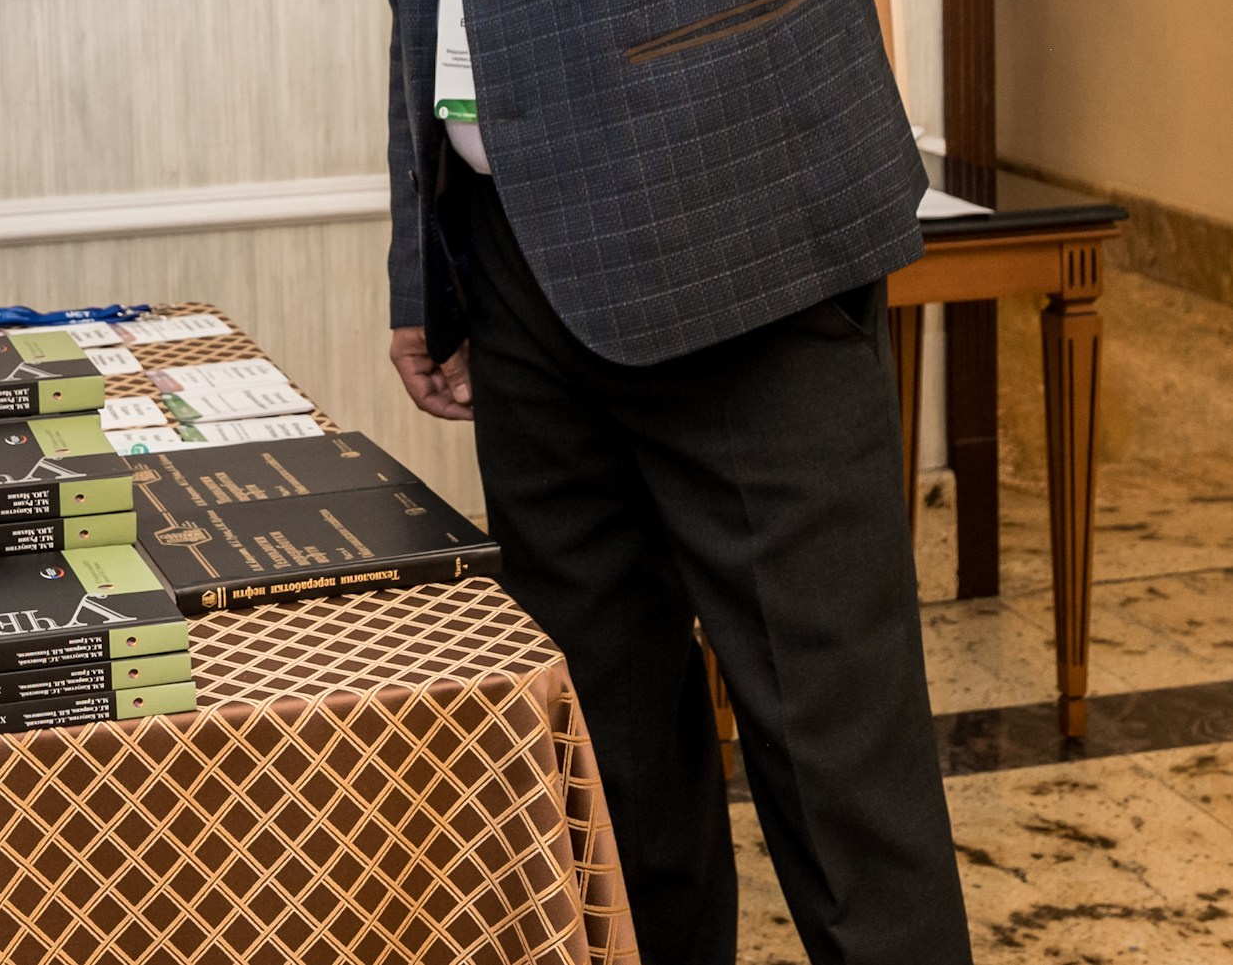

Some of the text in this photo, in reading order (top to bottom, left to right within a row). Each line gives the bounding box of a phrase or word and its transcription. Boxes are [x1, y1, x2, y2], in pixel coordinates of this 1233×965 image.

[232, 570, 400, 600] Технология переработки нефти
